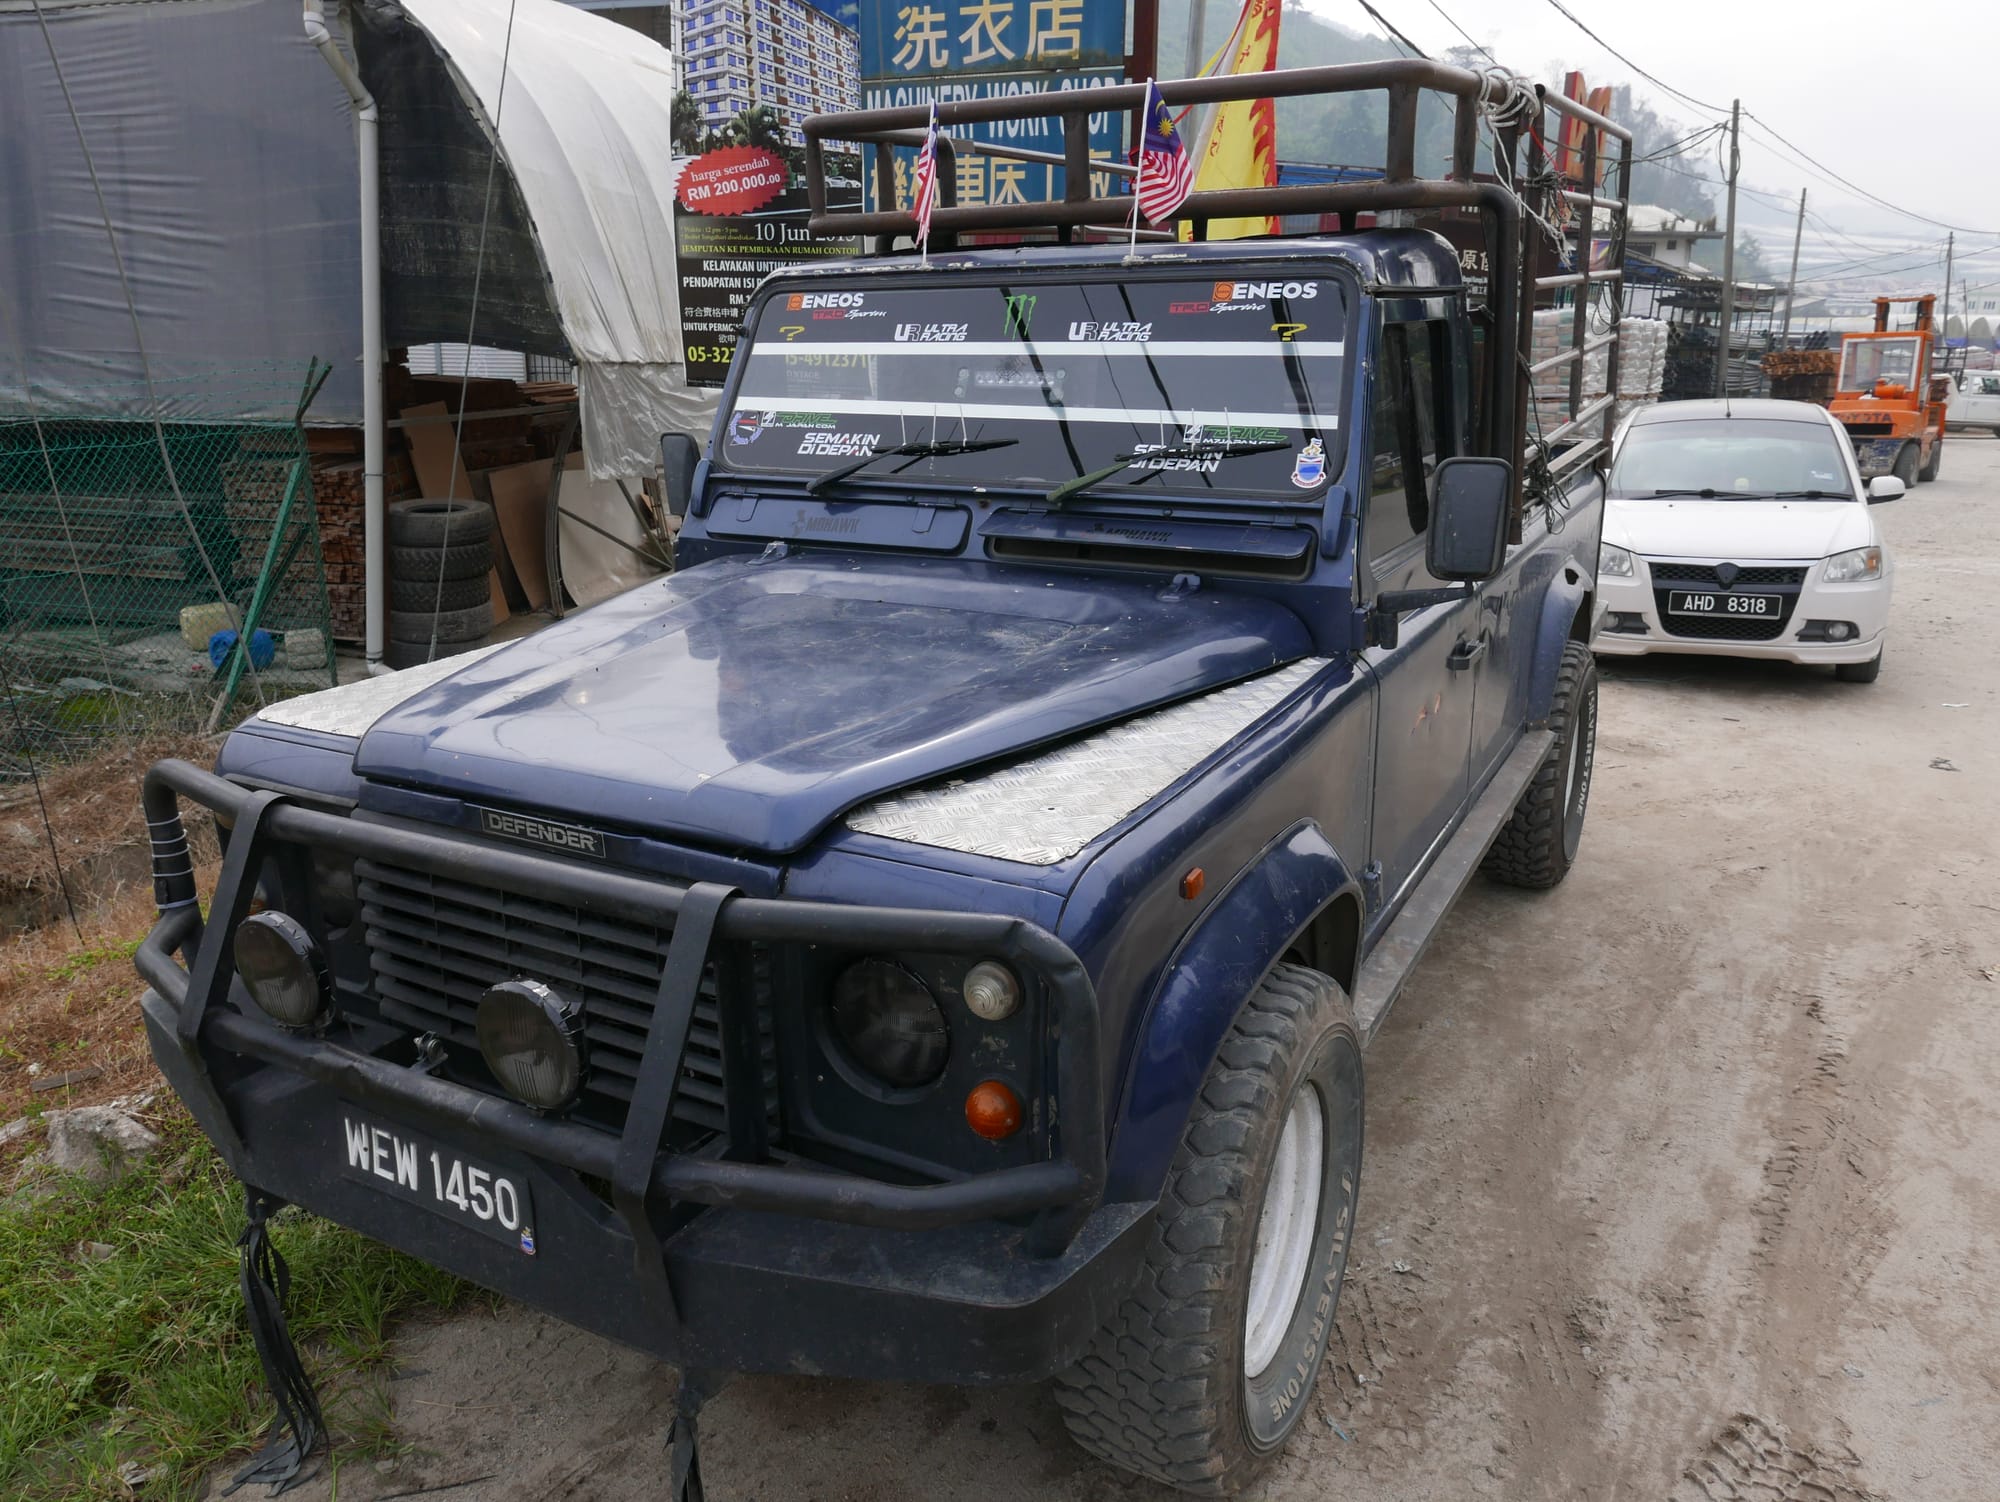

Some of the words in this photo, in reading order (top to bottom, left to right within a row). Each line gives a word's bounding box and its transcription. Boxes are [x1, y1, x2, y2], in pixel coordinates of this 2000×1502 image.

[892, 0, 1083, 70] 洗衣店
[1060, 77, 1116, 135] OP
[690, 169, 721, 182] harga
[723, 157, 770, 175] serendah
[687, 187, 711, 201] RM
[713, 173, 781, 196] 200,000.00
[754, 223, 775, 241] 10
[779, 223, 811, 245] Jun
[682, 245, 725, 253] JEMPUTAN
[727, 245, 737, 253] KE
[739, 245, 791, 254] PEMBUKAAN
[792, 246, 822, 254] RUMAH
[823, 247, 859, 255] CONTOH
[703, 260, 755, 272] KELAYAKAN
[756, 261, 787, 272] UNTUK
[683, 277, 741, 288] PENDAPATAN
[743, 278, 755, 289] ISI
[1232, 282, 1318, 299] ENEOS
[801, 292, 864, 309] ENEOS
[683, 322, 708, 331] UNTUK
[924, 323, 968, 333] ULTRA
[1101, 321, 1152, 332] ULTRA
[920, 332, 968, 342] RACING
[1097, 331, 1151, 342] RACING
[815, 445, 875, 457] DEPAN
[1148, 457, 1220, 473] DEPAN
[1683, 594, 1715, 611] AHD
[1727, 597, 1766, 613] 8318
[488, 813, 596, 851] DEFENDER
[344, 1117, 418, 1191] WEW
[430, 1151, 519, 1231] 1450
[1271, 1206, 1349, 1423] SILVERSTONE
